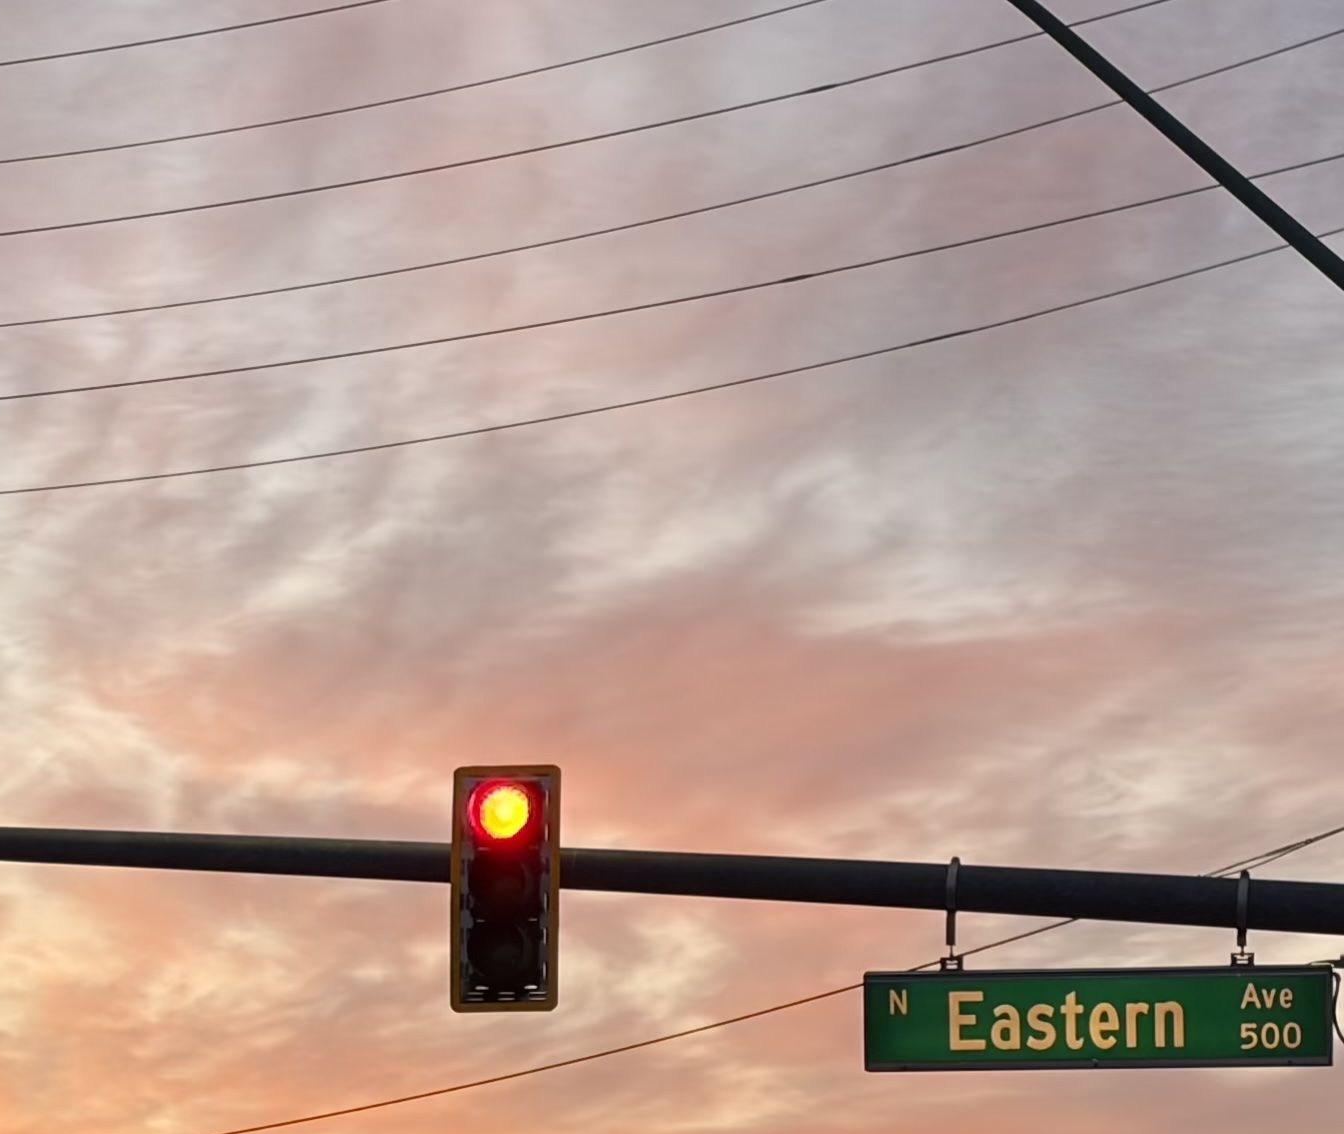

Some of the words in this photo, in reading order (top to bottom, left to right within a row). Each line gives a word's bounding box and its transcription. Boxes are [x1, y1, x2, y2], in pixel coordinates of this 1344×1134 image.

[889, 988, 908, 1017] N
[947, 990, 1185, 1051] Eastern
[1240, 982, 1294, 1010] Ave
[1240, 1021, 1302, 1051] 500
